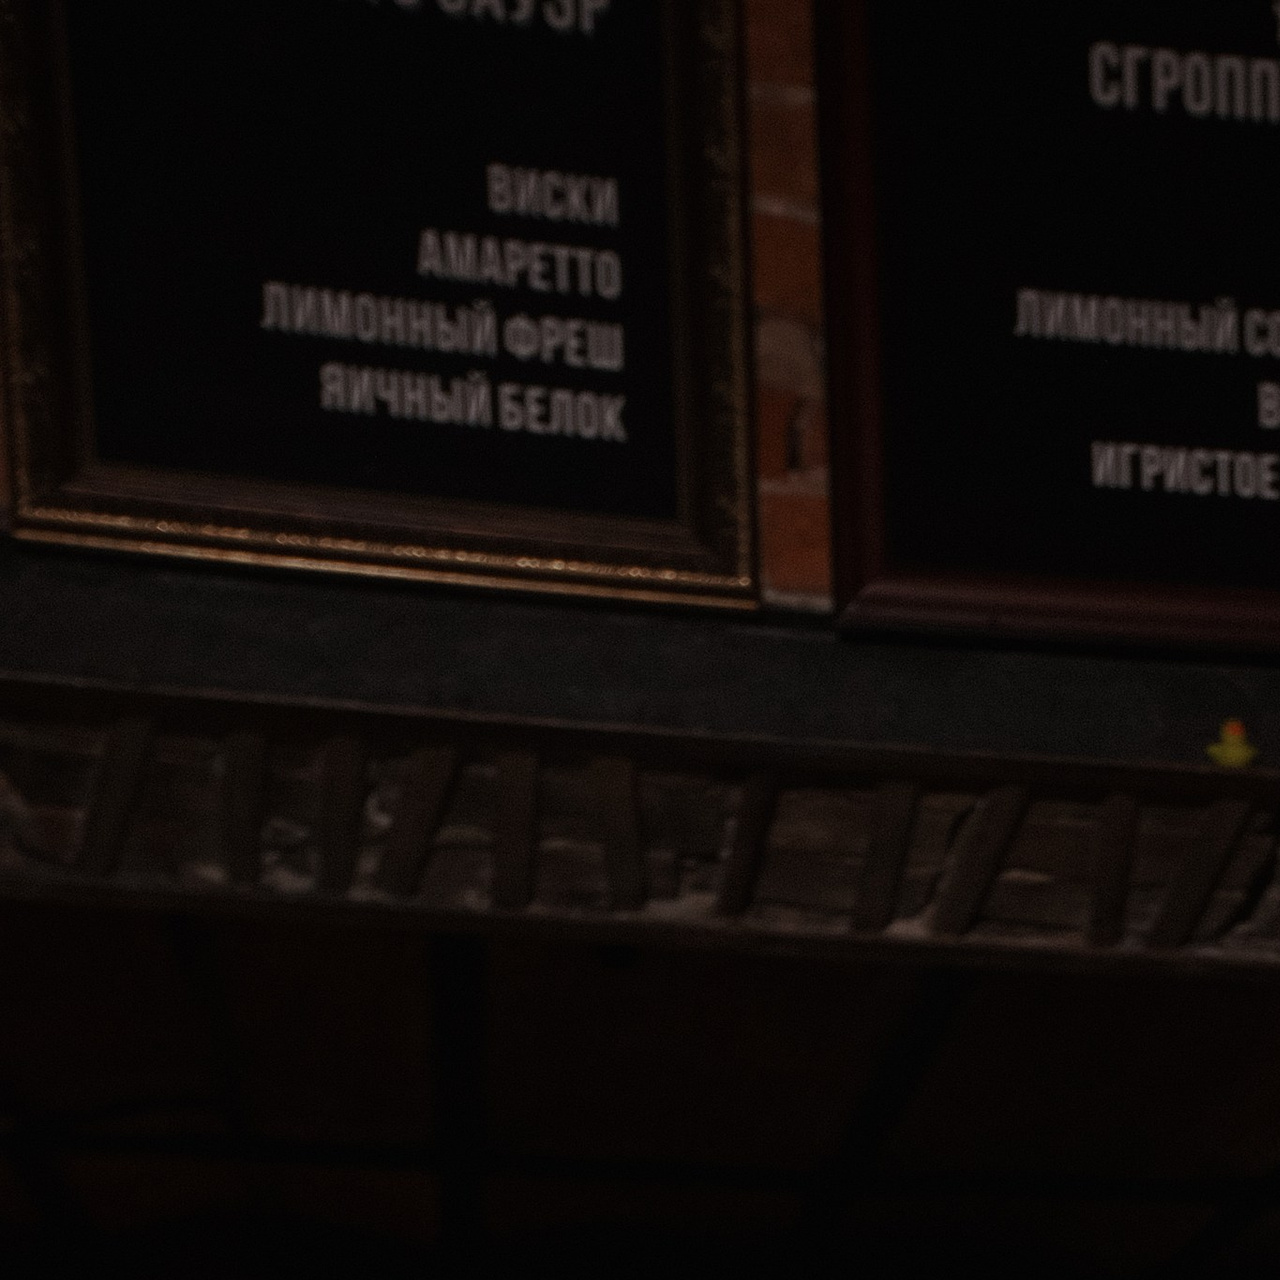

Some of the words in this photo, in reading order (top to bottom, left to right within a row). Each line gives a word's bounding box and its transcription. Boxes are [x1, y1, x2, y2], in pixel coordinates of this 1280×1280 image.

[486, 162, 620, 226] ВИСКИ
[417, 227, 622, 300] АМАРЕТТО
[260, 280, 499, 357] ЛИМОННЫЙ
[504, 314, 624, 371] ФРЕШ
[1015, 289, 1238, 353] ЛИМОННЫЙ
[320, 363, 492, 427] ЯИЧНЫЙ
[498, 383, 626, 441] БЕЛОК
[1092, 442, 1280, 500] ИГРИСТОЕ
